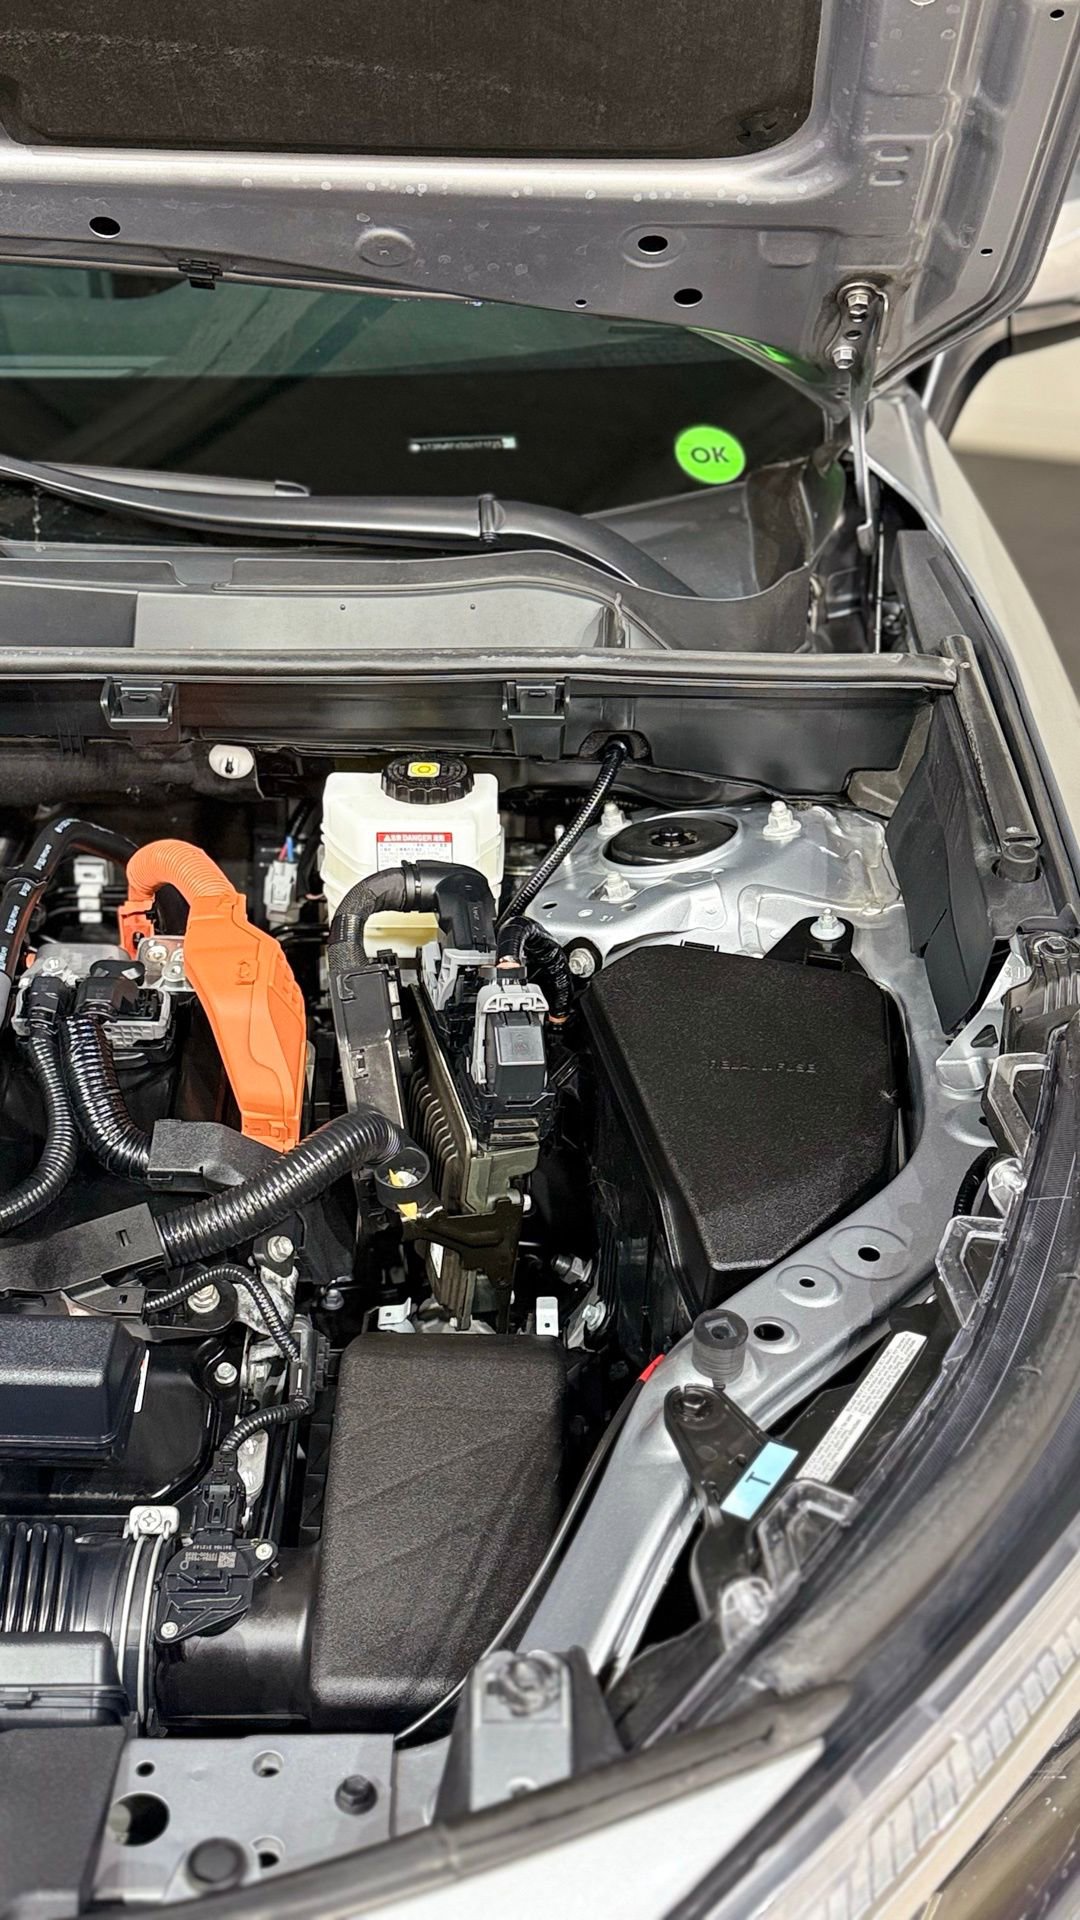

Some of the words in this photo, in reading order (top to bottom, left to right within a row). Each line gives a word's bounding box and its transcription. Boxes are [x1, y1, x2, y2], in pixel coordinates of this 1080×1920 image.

[691, 446, 730, 464] OK
[403, 833, 432, 842] DANGER
[745, 1471, 772, 1486] T
